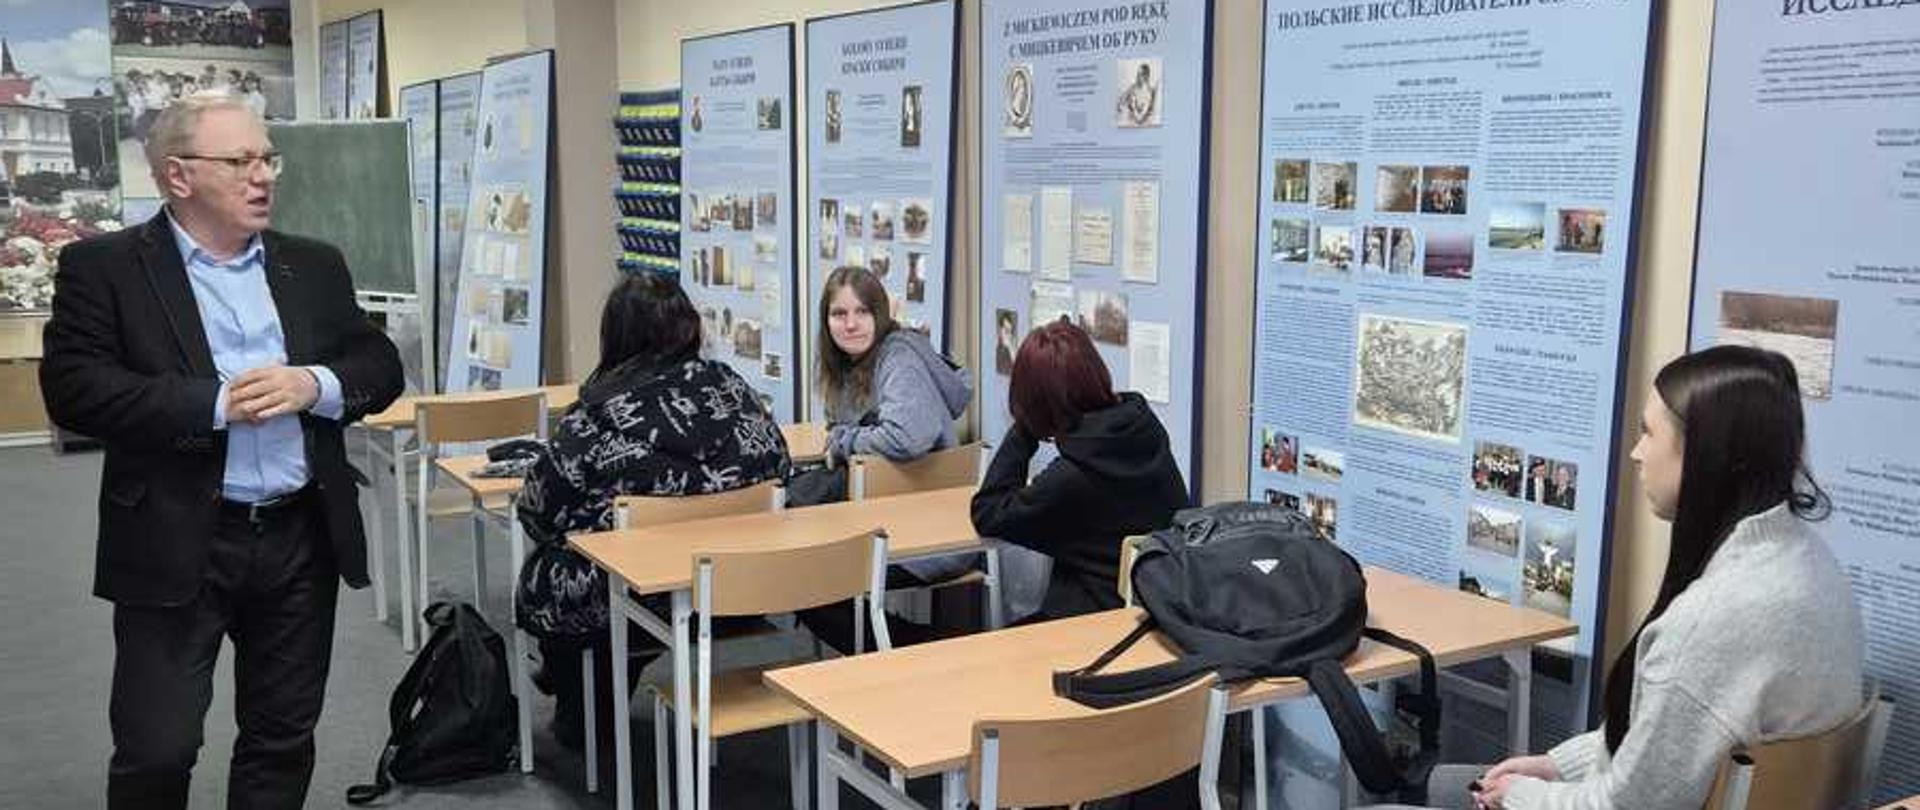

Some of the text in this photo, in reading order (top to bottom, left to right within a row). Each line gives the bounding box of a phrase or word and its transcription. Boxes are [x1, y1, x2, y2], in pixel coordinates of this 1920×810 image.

[1102, 5, 1129, 25] POD
[1278, 5, 1363, 30] ПОЛЬСКИЕ
[1102, 30, 1121, 49] ОБ
[1123, 27, 1159, 47] РУКУ
